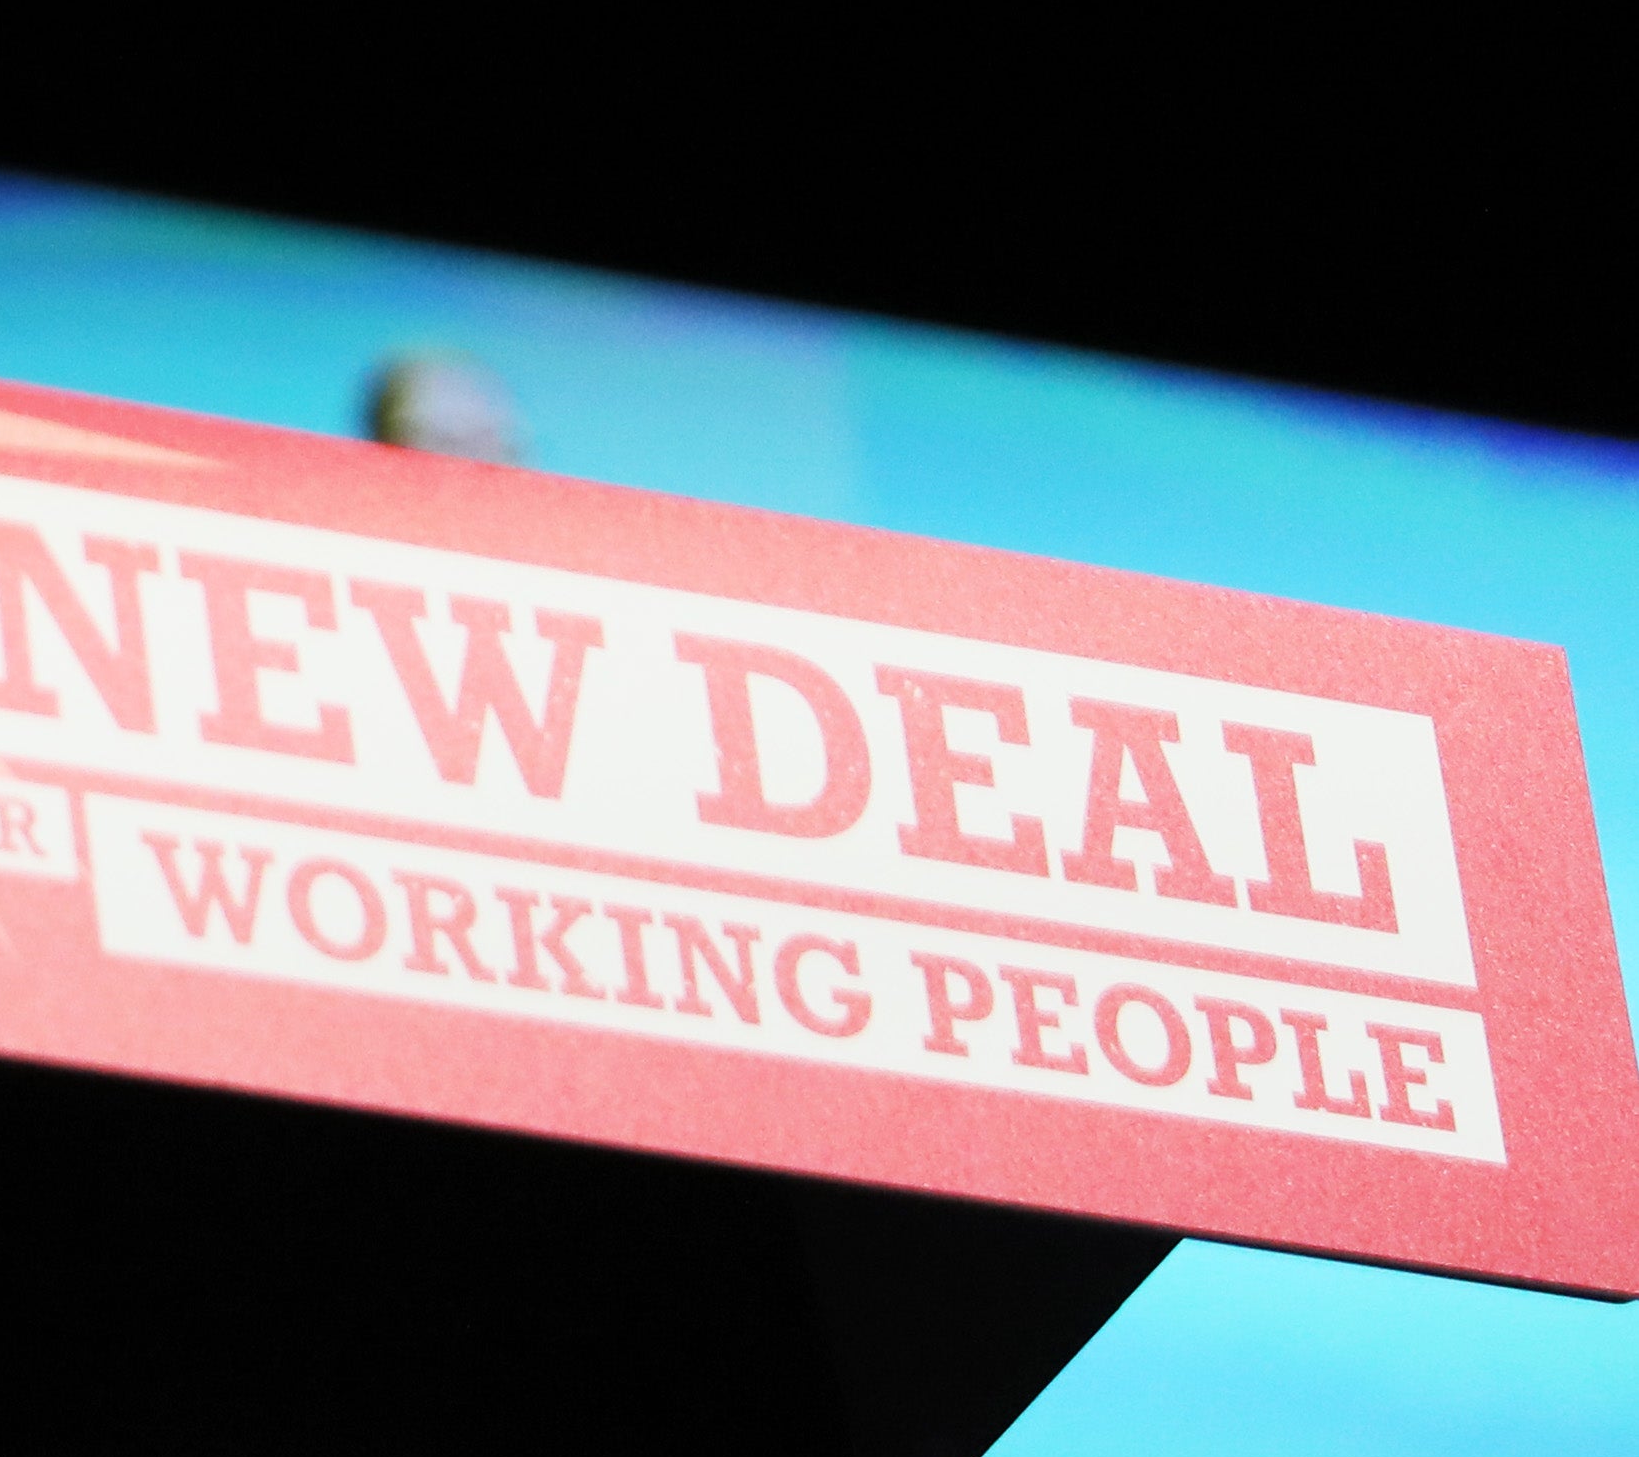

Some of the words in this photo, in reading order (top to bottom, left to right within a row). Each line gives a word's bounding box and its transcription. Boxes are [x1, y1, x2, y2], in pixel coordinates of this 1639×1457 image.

[672, 629, 1400, 935] DEAL
[139, 829, 873, 1040] WORKING
[909, 948, 1457, 1134] PEOPLE
